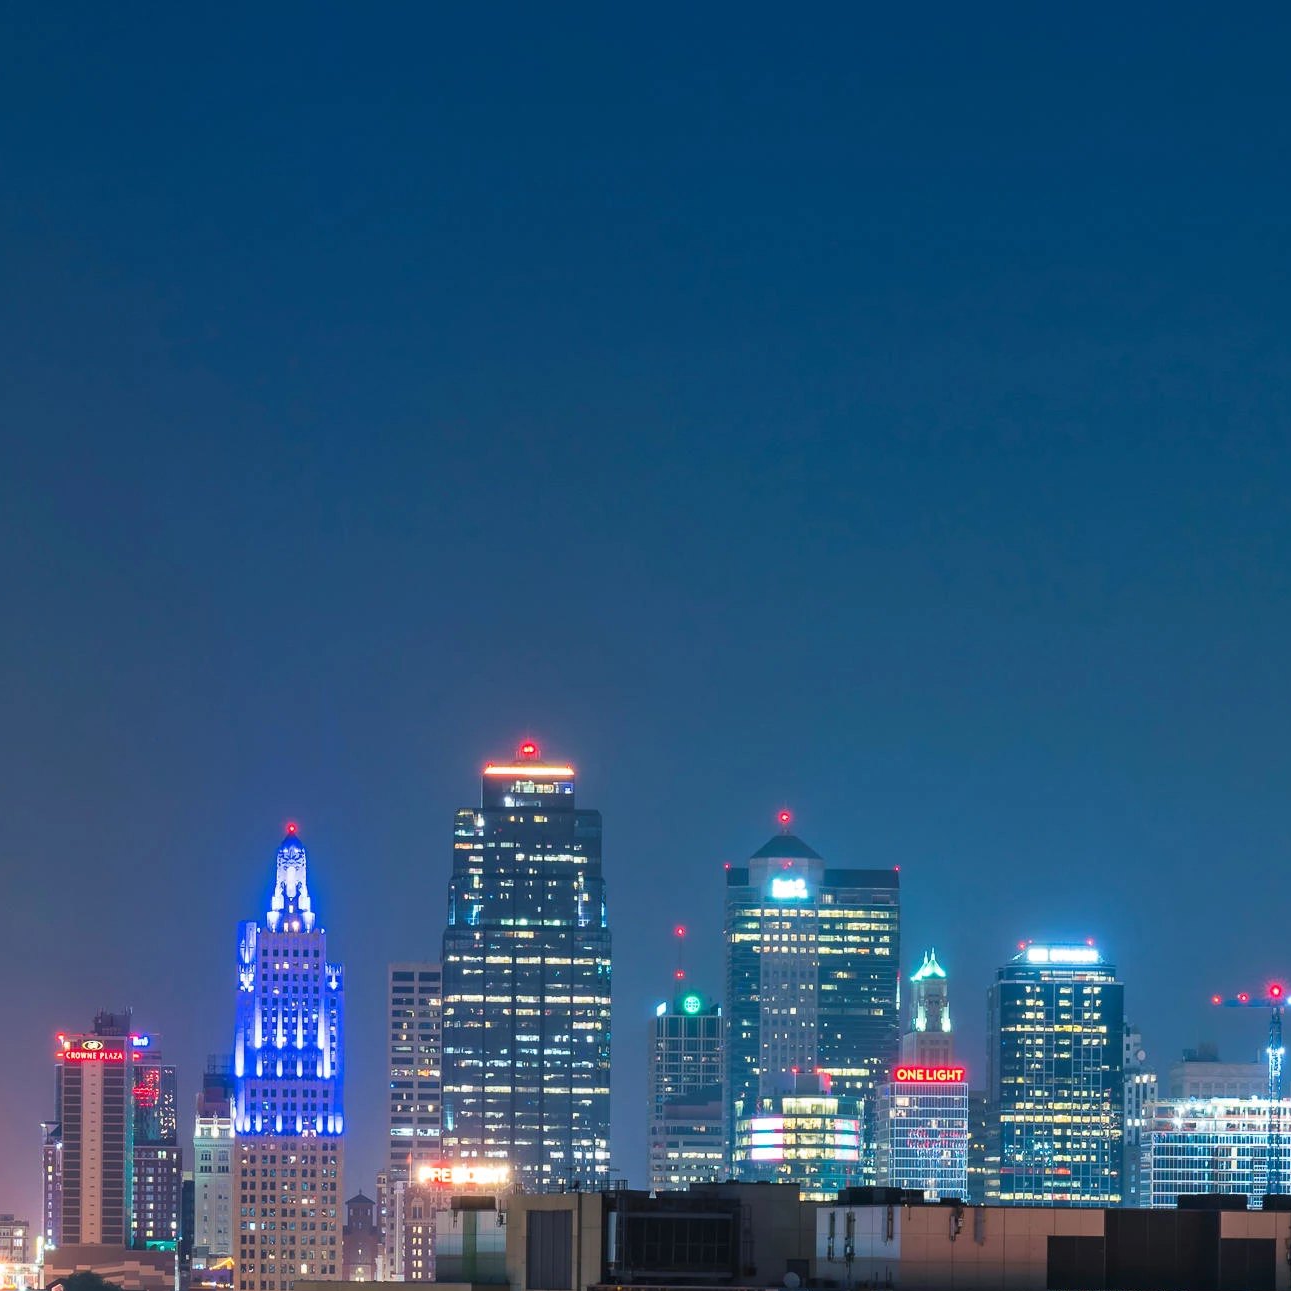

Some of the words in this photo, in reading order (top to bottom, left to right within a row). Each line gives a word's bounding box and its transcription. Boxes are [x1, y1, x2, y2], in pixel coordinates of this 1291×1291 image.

[65, 1051, 97, 1060] CROWNE
[99, 1051, 123, 1060] PLAZA
[896, 1068, 924, 1081] ONE
[925, 1068, 963, 1081] LIGHT
